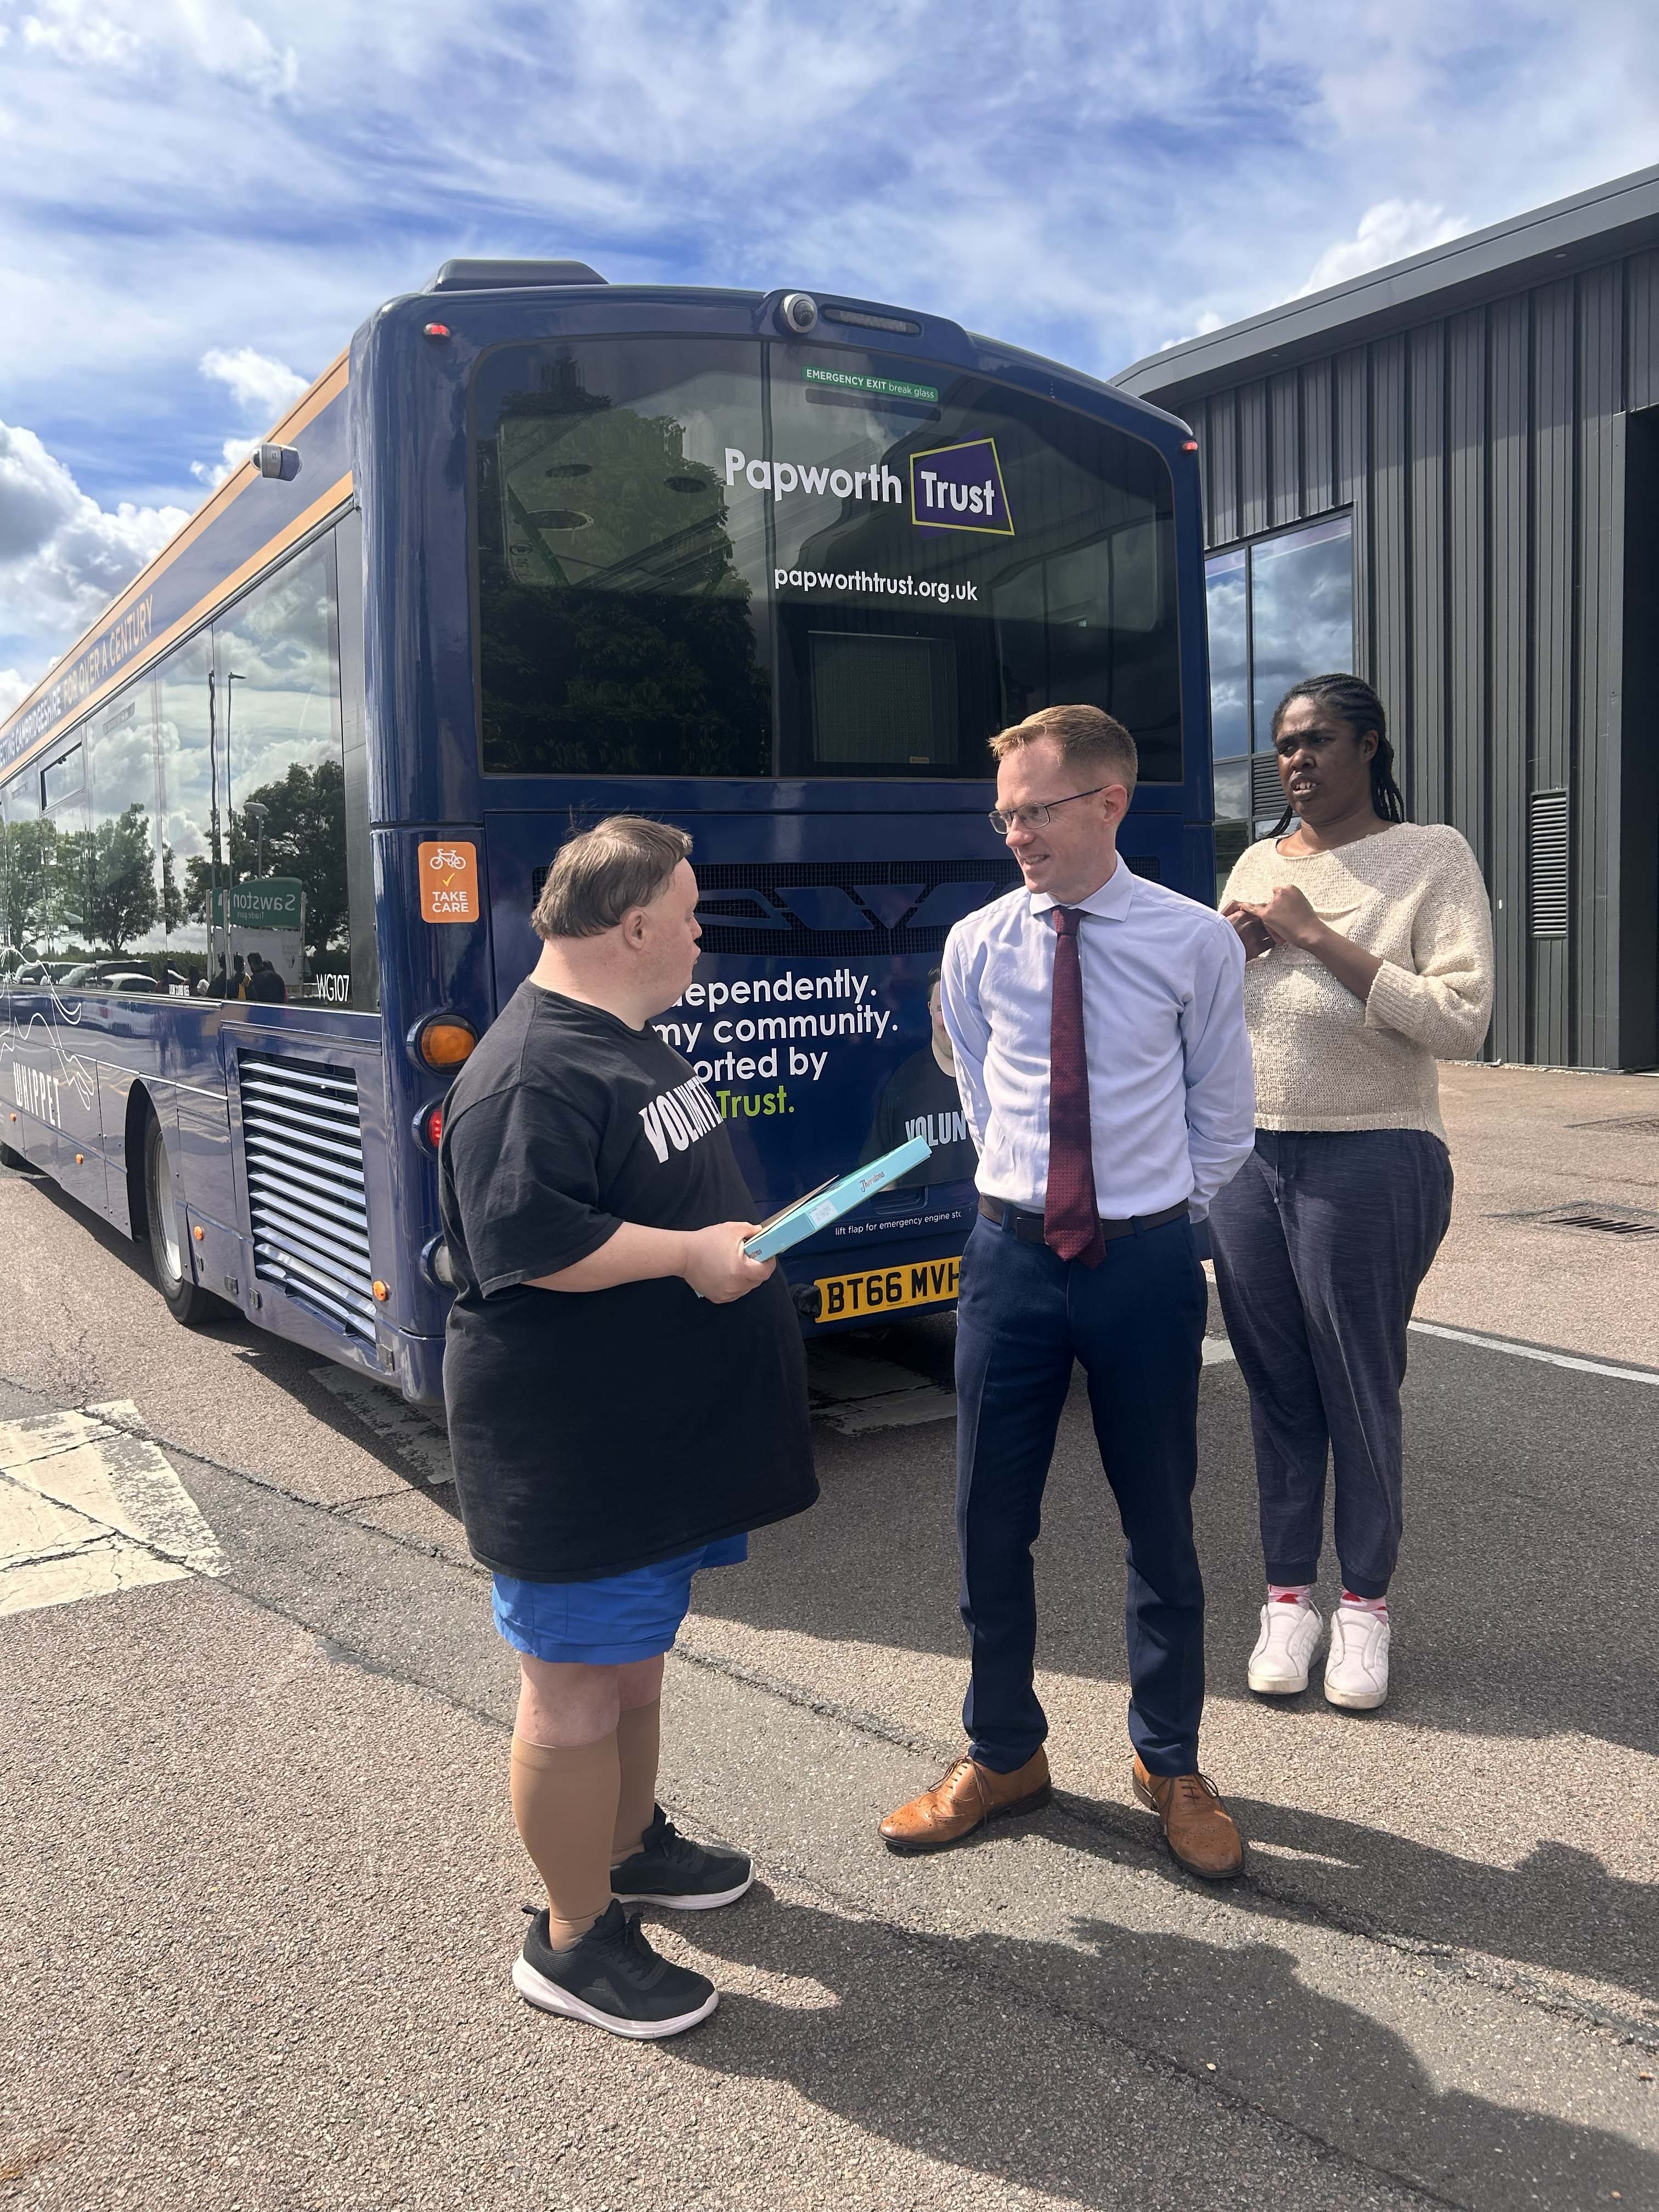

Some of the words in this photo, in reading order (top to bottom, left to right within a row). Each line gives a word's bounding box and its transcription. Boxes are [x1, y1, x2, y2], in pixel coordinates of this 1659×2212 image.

[806, 368, 864, 386] EMERGENCY
[866, 379, 887, 390] EXIT
[889, 383, 912, 395] break
[914, 387, 934, 399] glass
[725, 447, 902, 504] Papworth
[921, 471, 995, 516] Trust
[774, 567, 978, 603] papworthtrust.org.uk
[15, 686, 61, 753] CAMBRIDGESHIRE
[63, 670, 78, 709] FOR
[79, 648, 100, 694] OVER
[102, 641, 108, 676] A
[110, 594, 153, 667] CENTURY
[432, 891, 467, 901] TAKE
[432, 902, 469, 913] CARE
[316, 973, 349, 1002] WG107
[671, 968, 877, 1013] ependently.
[652, 1022, 703, 1053] my
[713, 1005, 898, 1043] community.
[789, 1046, 828, 1081] by
[13, 1061, 61, 1130] WHIPPET
[716, 1085, 795, 1119] Trust.
[638, 1075, 724, 1164] VOLUNTE
[905, 1110, 966, 1147] VOLUN
[835, 1227, 846, 1235] lift
[848, 1225, 864, 1234] flap
[866, 1223, 877, 1232] for
[879, 1217, 922, 1229] emergency
[924, 1212, 950, 1223] engine
[827, 1272, 902, 1314] BT66
[911, 1260, 961, 1299] MVH
